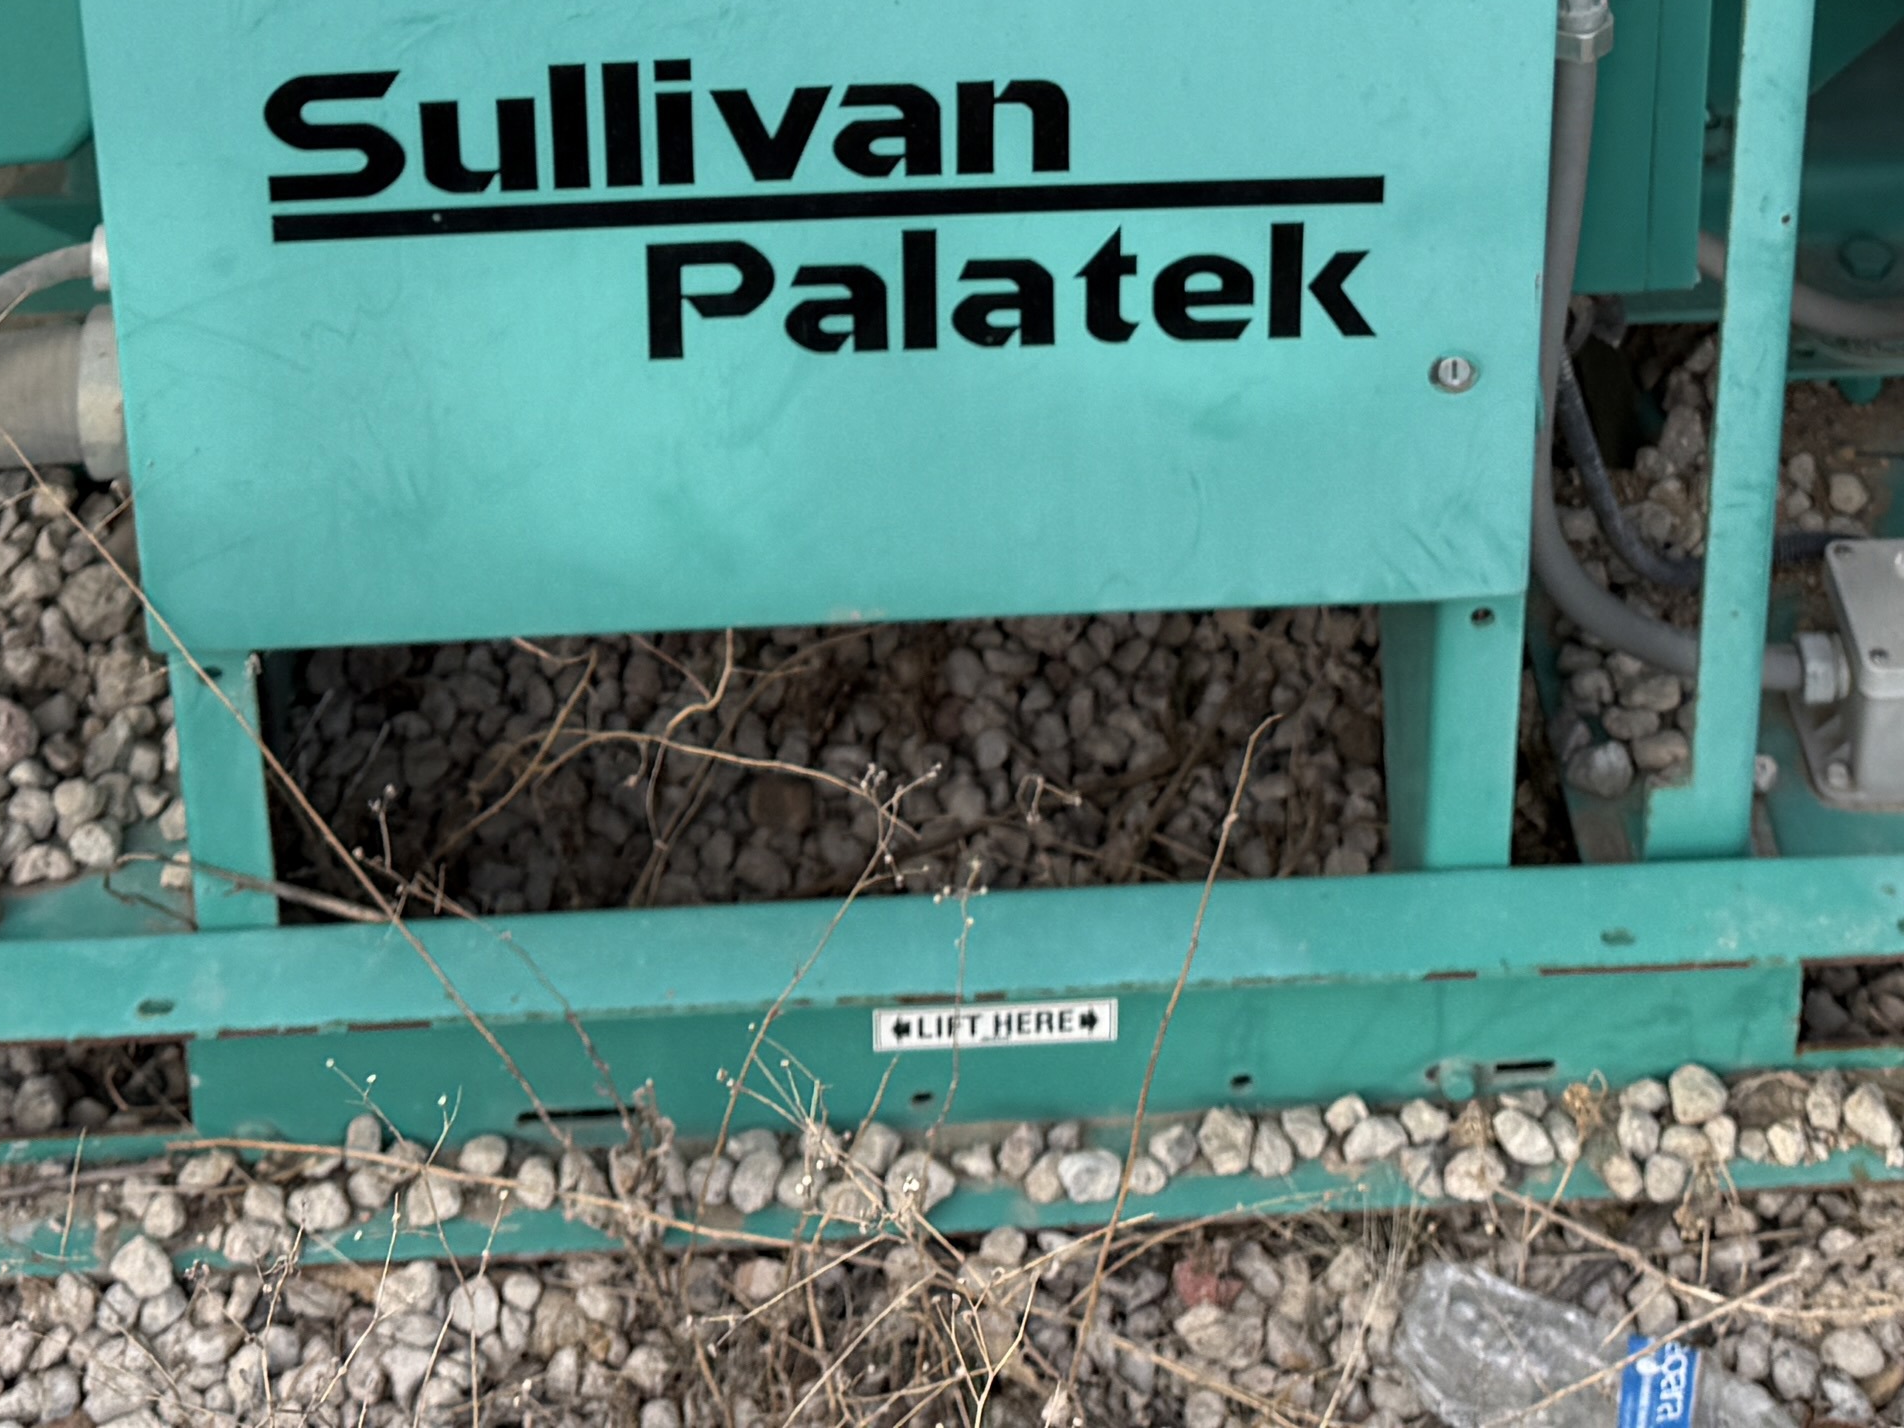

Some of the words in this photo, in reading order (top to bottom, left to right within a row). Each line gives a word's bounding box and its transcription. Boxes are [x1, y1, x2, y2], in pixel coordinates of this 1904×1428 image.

[262, 58, 1070, 204] Sullivan
[645, 221, 1379, 361] Palatek
[917, 1014, 981, 1039] LIFT
[994, 1009, 1073, 1035] HERE
